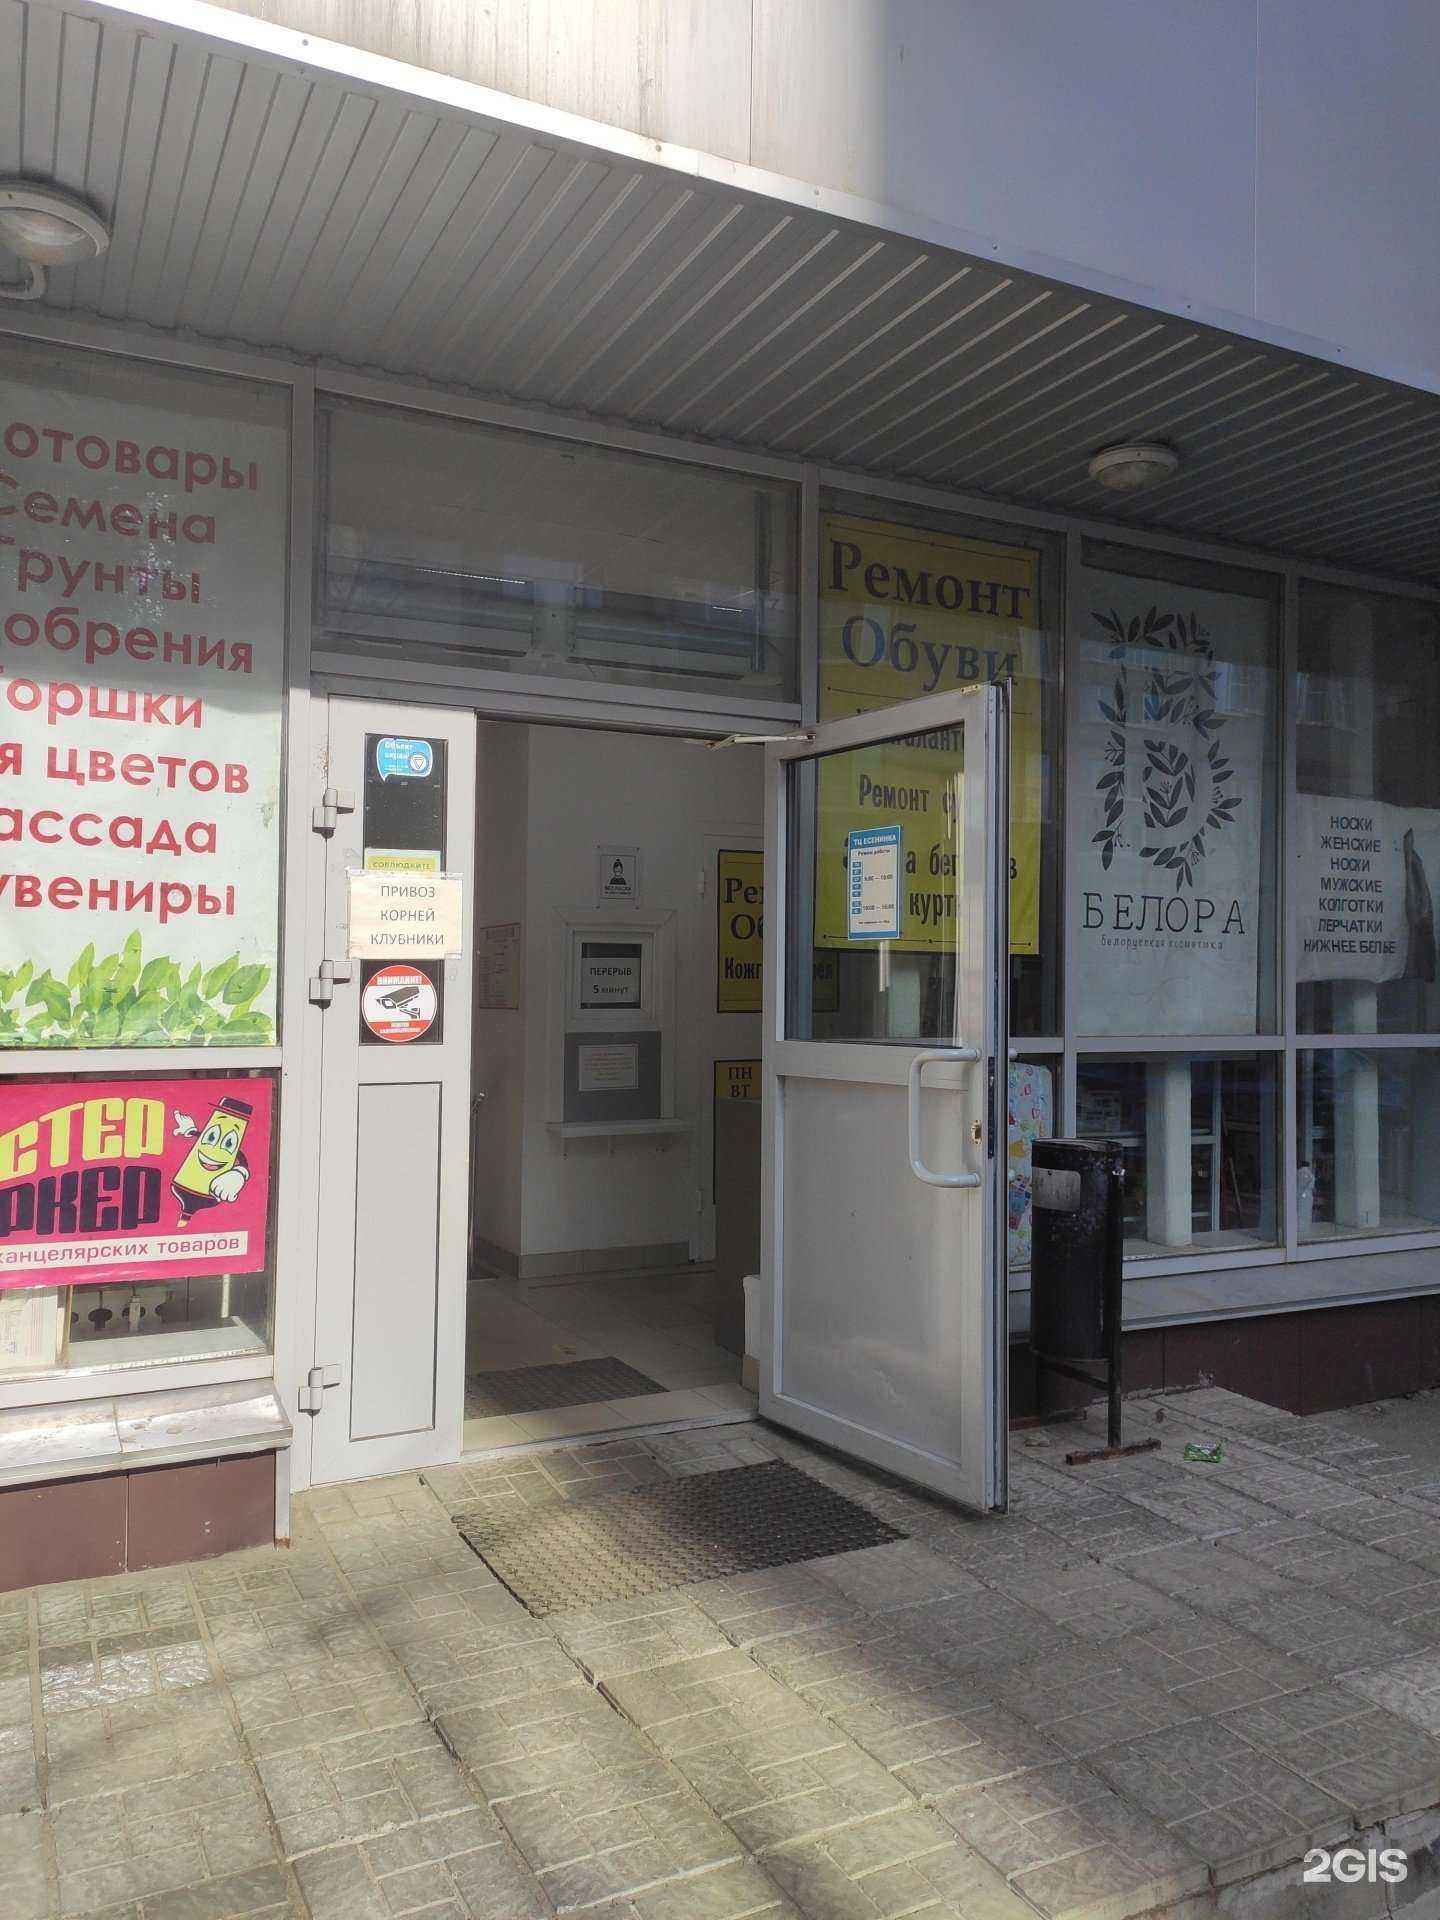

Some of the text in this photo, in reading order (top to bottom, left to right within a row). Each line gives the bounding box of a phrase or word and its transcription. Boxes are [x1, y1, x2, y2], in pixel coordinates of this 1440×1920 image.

[0, 535, 201, 604] рунты
[829, 538, 1031, 619] Ремонт
[842, 615, 1018, 692] Обуви
[0, 665, 204, 728] оршки
[47, 746, 250, 794] цветов
[859, 774, 929, 813] Ремонт
[1330, 816, 1373, 832] НОСКИ
[1320, 836, 1381, 853] ЖЕНСКИЕ
[1330, 857, 1371, 872] НОСКИ
[381, 885, 436, 898] ПРИВОЗ
[1320, 877, 1383, 893] МУЖСКИЕ
[909, 892, 957, 926] курт
[1082, 891, 1246, 935] БЕЛОРА
[1319, 897, 1384, 913] КОЛГОТКИ
[380, 909, 435, 921] КОРНЕЙ
[1318, 918, 1383, 933] ПЕРЧАТКИ
[370, 933, 445, 946] КЛУБНИКИ
[1303, 938, 1396, 954] НИЖНЕЕ БЕЛЬЕ
[589, 967, 632, 977] ПЕРЕРЫВ
[593, 984, 629, 995] 5 минут
[731, 1084, 751, 1099] ВТ
[157, 1237, 240, 1256] товаров
